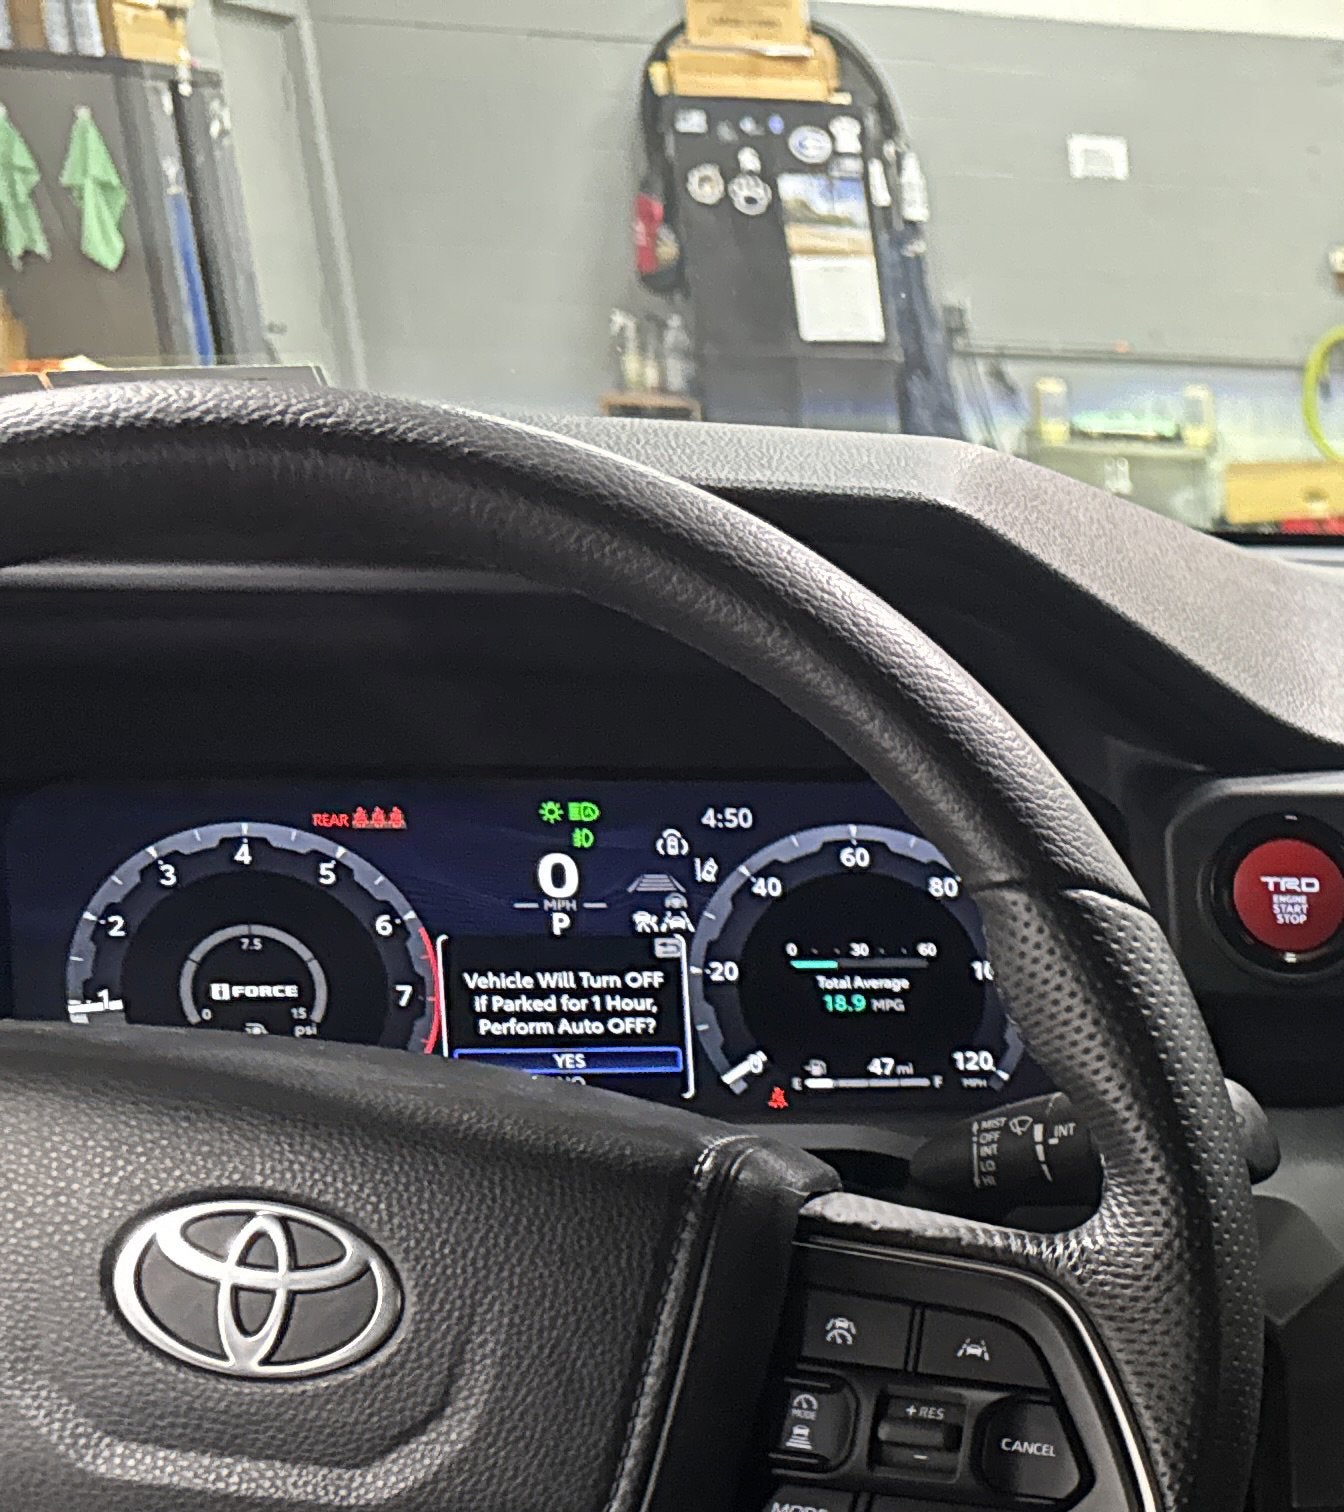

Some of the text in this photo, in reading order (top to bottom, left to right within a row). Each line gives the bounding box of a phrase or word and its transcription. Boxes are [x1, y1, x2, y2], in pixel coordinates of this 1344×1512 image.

[312, 812, 349, 828] REAR
[701, 808, 753, 829] 4:50
[234, 845, 252, 866] 4
[839, 848, 871, 868] 60
[160, 864, 177, 886] 3
[318, 865, 336, 885] 5
[538, 854, 579, 898] 0
[751, 877, 782, 897] 40
[927, 877, 959, 897] 80
[1260, 876, 1320, 893] TRD
[543, 900, 577, 912] MPH
[1272, 903, 1308, 914] START
[108, 915, 126, 937] 2
[375, 915, 393, 935] 6
[552, 912, 571, 936] P
[1276, 914, 1308, 925] STOP
[240, 937, 263, 951] 7.5
[786, 943, 798, 957] 0
[850, 943, 870, 957] 30
[916, 943, 938, 957] 60
[463, 971, 665, 989] Vehicle Will Turn OFF
[708, 961, 739, 981] 20
[816, 975, 910, 992] Total Average
[395, 985, 413, 1008] 7
[474, 994, 658, 1014] If Parked for 1 Hour,
[823, 994, 905, 1012] 18.9 MPG
[201, 1008, 213, 1020] 0
[291, 1007, 307, 1020] 15
[294, 1022, 318, 1038] psi
[479, 1017, 657, 1035] Perform Auto OFF?
[552, 1053, 587, 1069] YES
[867, 1058, 914, 1076] 47 mi
[953, 1052, 994, 1071] 120
[980, 1131, 1001, 1144] OFF
[1054, 1122, 1077, 1138] INT
[1001, 1437, 1056, 1458] CANCEL
